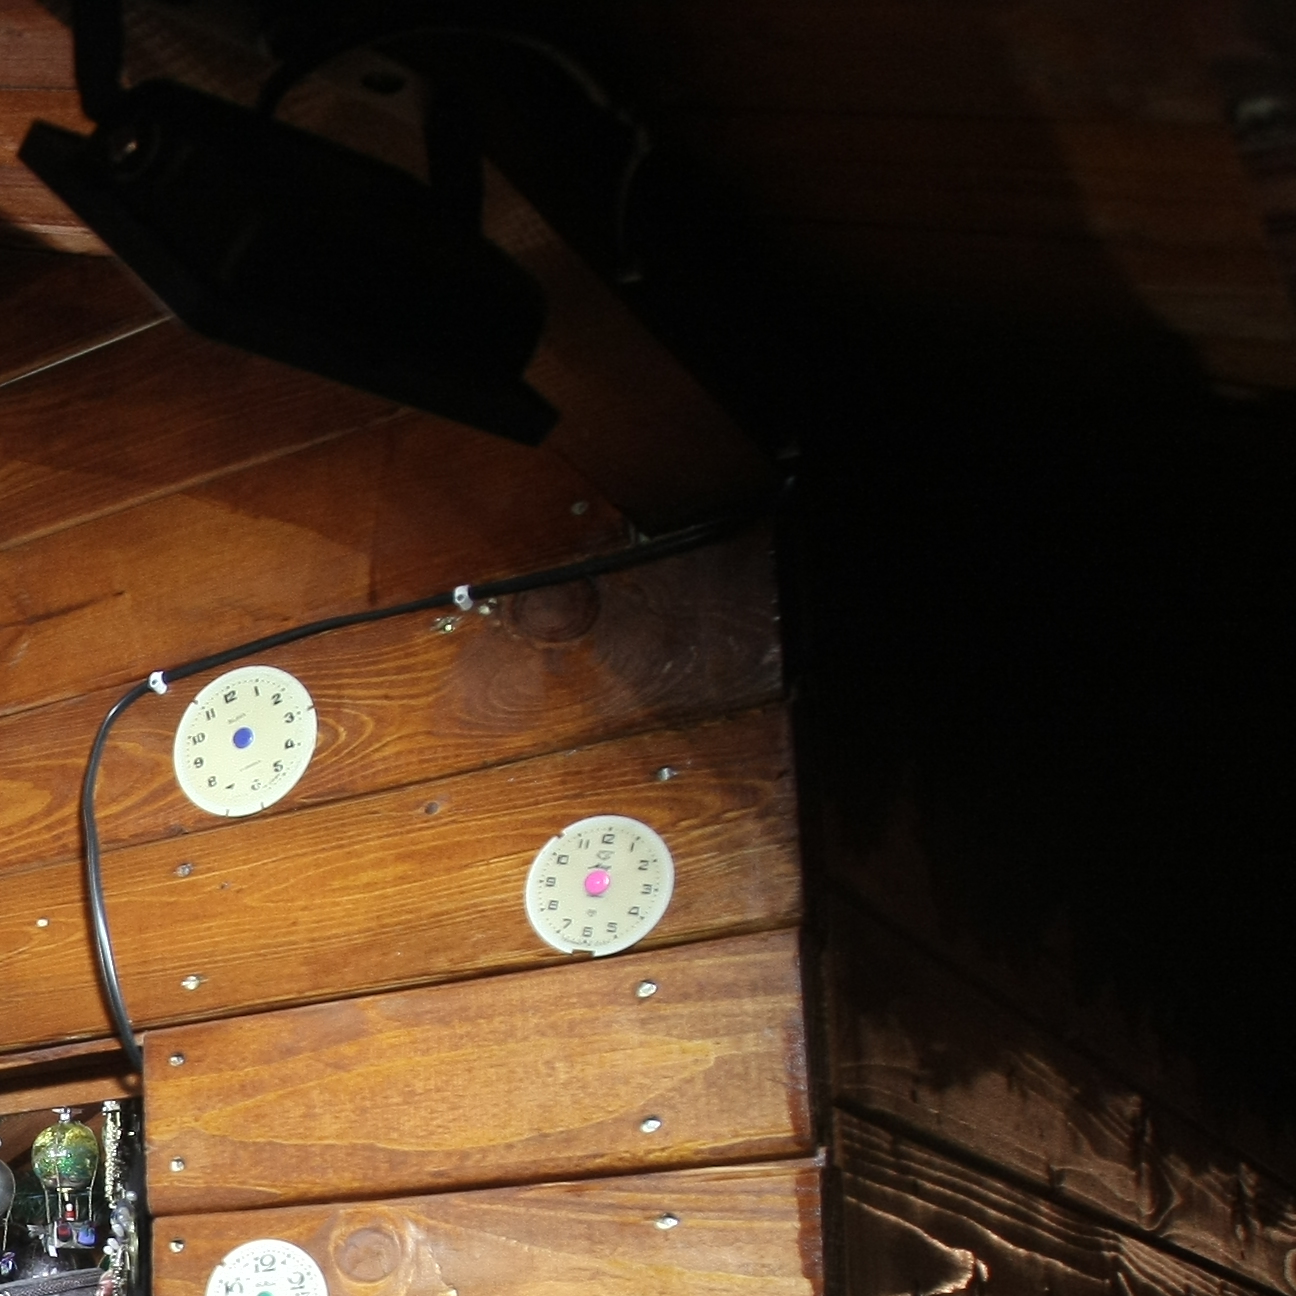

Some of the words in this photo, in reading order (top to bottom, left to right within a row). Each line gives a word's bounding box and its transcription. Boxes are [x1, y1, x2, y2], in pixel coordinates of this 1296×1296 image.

[223, 690, 238, 703] 12
[254, 686, 260, 696] 1
[271, 693, 283, 706] 2
[205, 708, 216, 721] 11
[284, 712, 295, 723] 3
[192, 732, 206, 745] 10
[284, 738, 295, 750] 4
[194, 757, 204, 768] 9
[273, 760, 284, 772] 5
[208, 776, 217, 787] 8
[578, 839, 590, 849] 11
[630, 842, 635, 852] 1
[638, 859, 649, 870] 2
[545, 876, 556, 887] 9
[641, 884, 652, 894] 3
[548, 900, 559, 910] 8
[562, 918, 572, 929] 7
[606, 922, 618, 933] 5
[582, 926, 593, 937] 6
[254, 1254, 277, 1273] 12
[287, 1271, 305, 1290] 2
